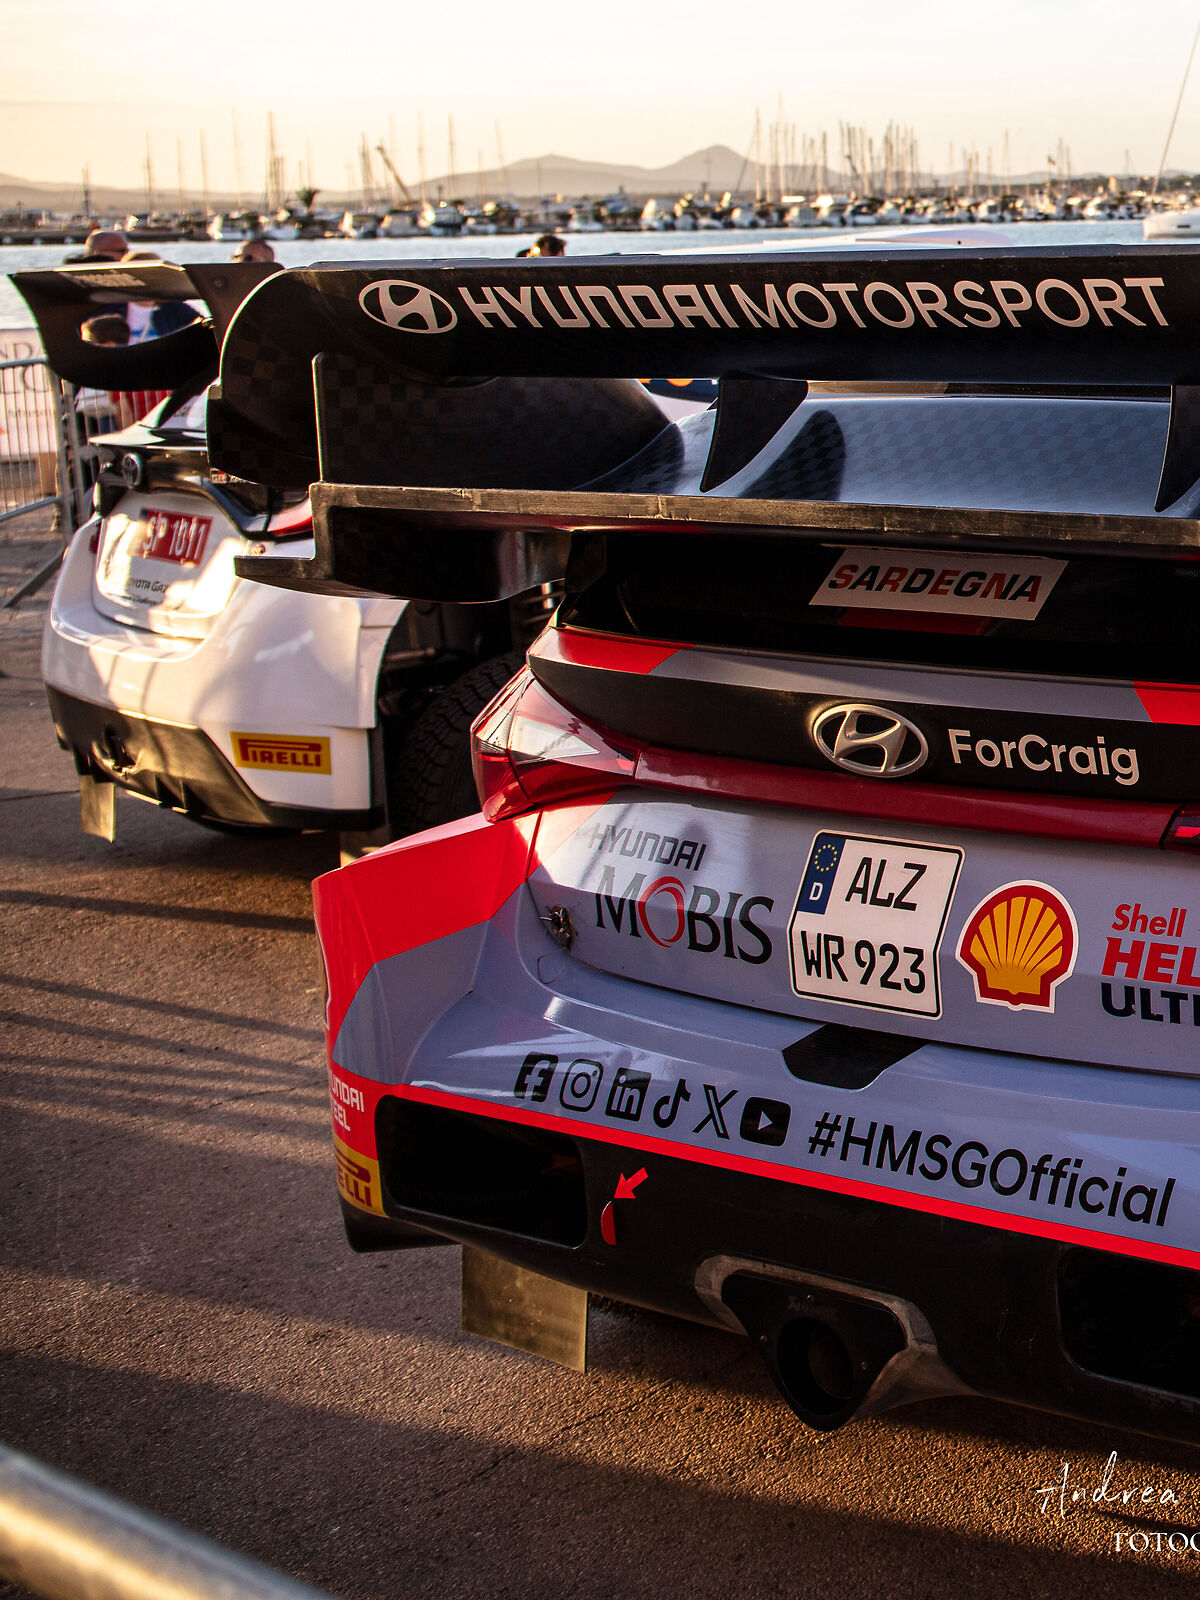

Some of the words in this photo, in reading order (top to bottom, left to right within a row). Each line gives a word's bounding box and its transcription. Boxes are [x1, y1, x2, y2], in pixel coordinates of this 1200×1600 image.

[458, 285, 735, 328] HYUNDAI
[730, 277, 1170, 329] MOTORSPORT
[828, 564, 1043, 603] SARDEGNA
[237, 738, 323, 768] PIRELLI
[948, 728, 1140, 786] ForCraig
[588, 822, 707, 872] HYUNDAI
[809, 882, 824, 901] D
[844, 856, 928, 912] ALZ
[595, 864, 775, 966] MOBIS
[1111, 903, 1188, 938] Shell
[800, 930, 850, 983] WR
[853, 938, 926, 995] 923
[330, 1071, 365, 1113] UNDAI
[335, 1146, 373, 1208] ELLI
[807, 1111, 1177, 1228] #HMSGOfficial
